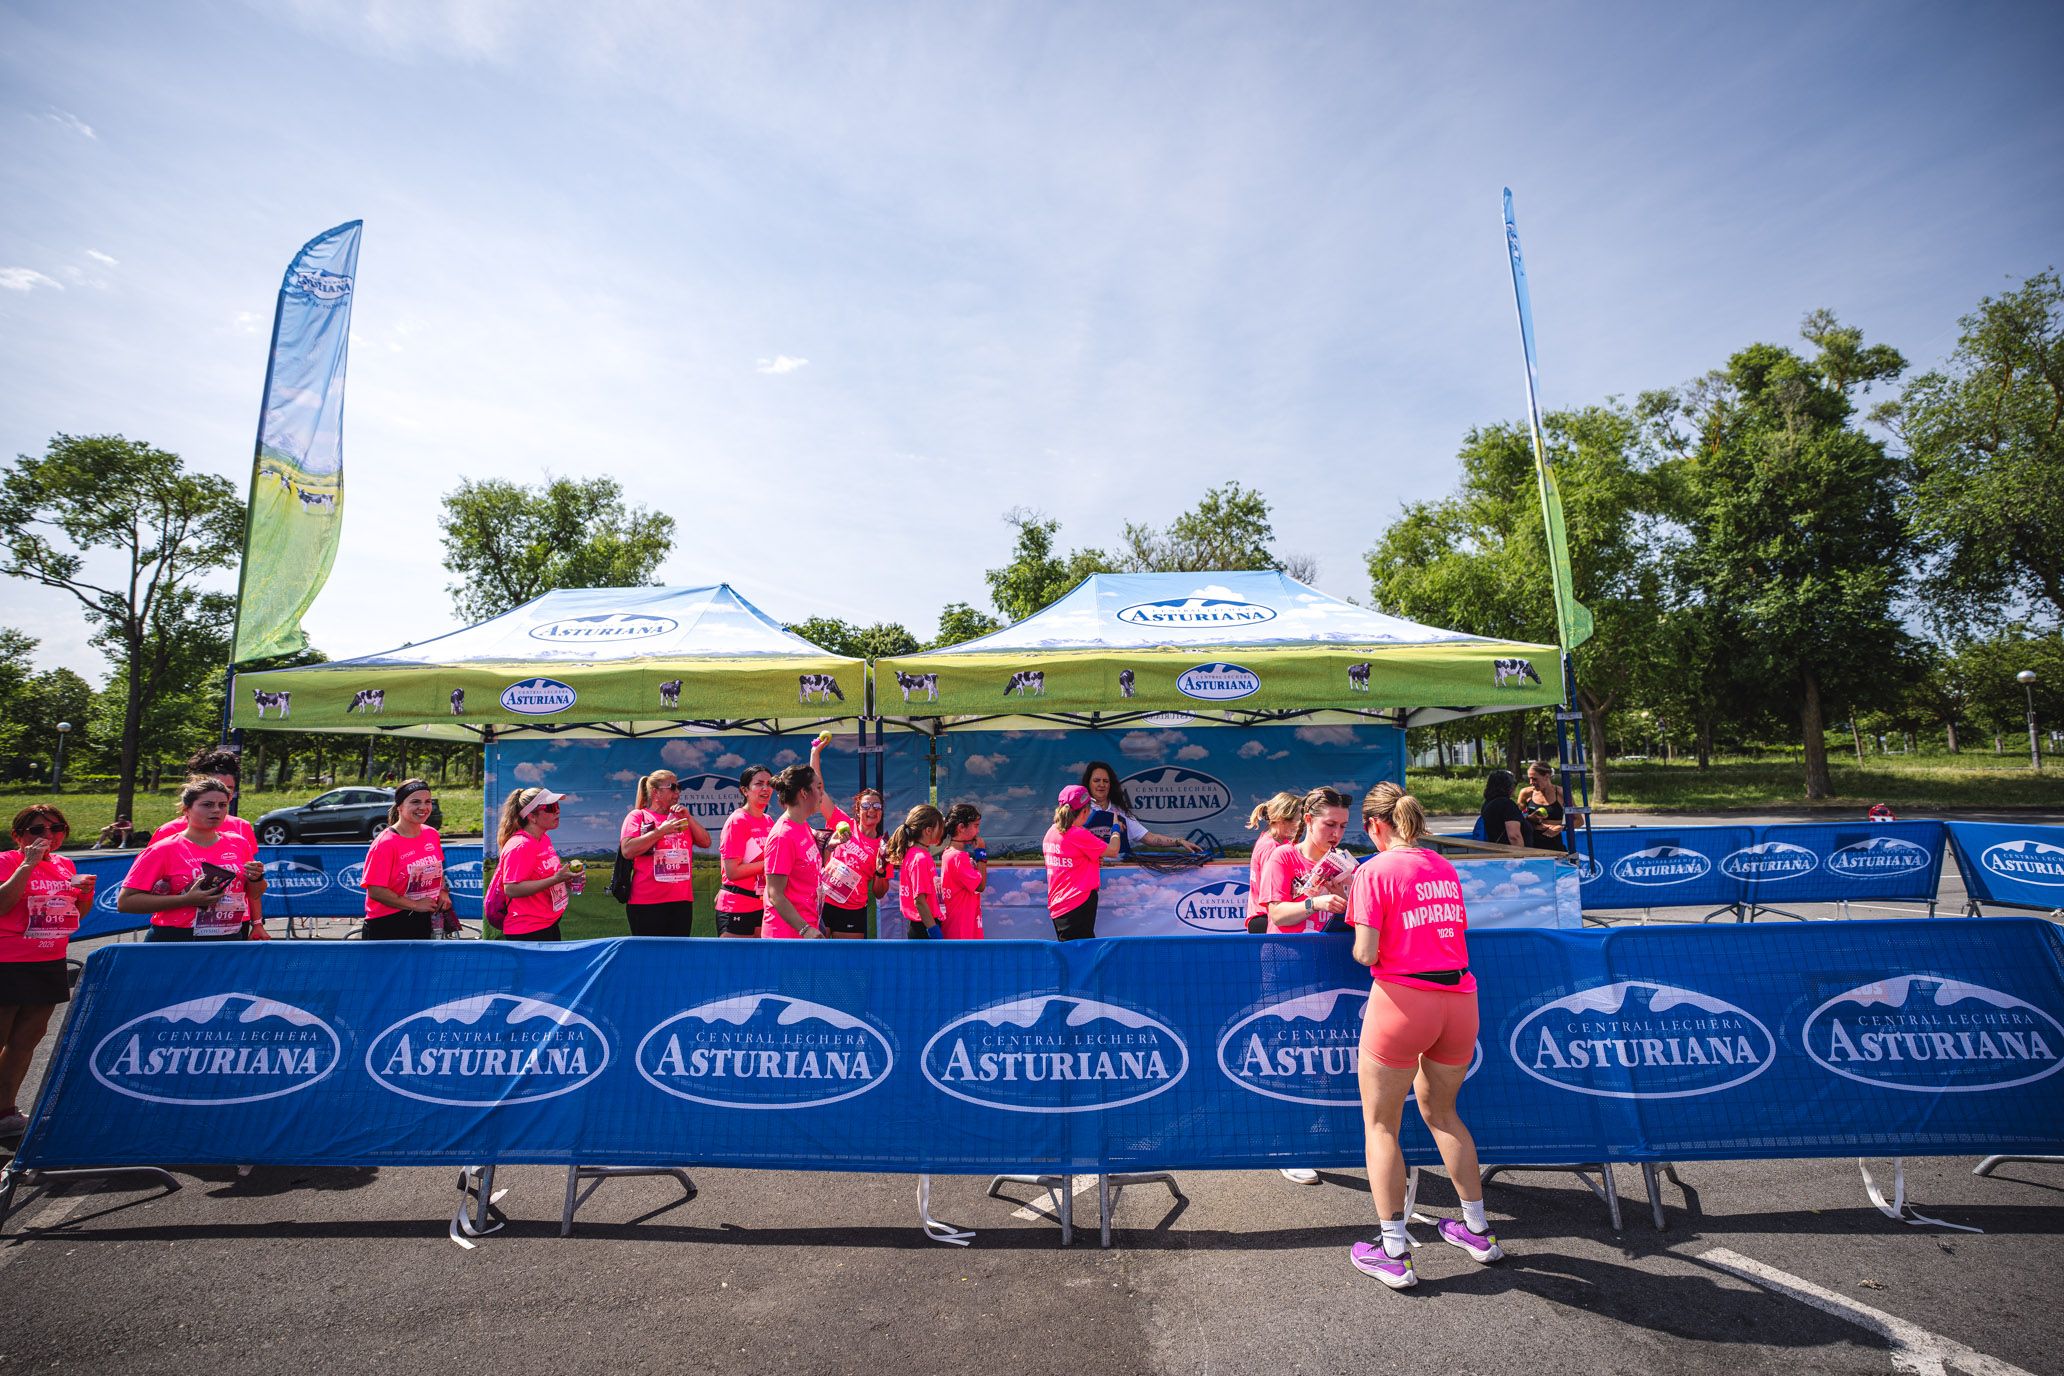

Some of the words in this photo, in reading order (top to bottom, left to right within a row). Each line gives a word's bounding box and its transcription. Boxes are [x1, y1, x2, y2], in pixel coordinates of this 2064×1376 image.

[1131, 609, 1265, 622] ASTURIANA
[539, 625, 664, 637] ASTURIANA
[1184, 676, 1254, 690] ASTURIANA
[507, 691, 570, 705] ASTURIANA
[1728, 857, 1811, 873] ASTURIANA
[1835, 851, 1922, 868] ASTURIANA
[1621, 862, 1704, 877] ASTURIANA
[31, 879, 75, 890] CARRER
[1415, 880, 1460, 902] SOMOS
[216, 911, 234, 919] 016
[1185, 900, 1247, 920] ASTURI
[46, 915, 65, 923] 016
[1567, 1021, 1653, 1033] CENTRAL
[1661, 1017, 1742, 1032] LECHERA
[1858, 1013, 1941, 1027] CENTRAL
[1948, 1012, 2034, 1026] LECHERA
[158, 1030, 233, 1041] CENTRAL
[241, 1030, 318, 1041] LECHERA
[427, 1031, 502, 1042] CENTRAL
[509, 1031, 585, 1042] LECHERA
[696, 1031, 775, 1045] CENTRAL
[782, 1033, 866, 1045] LECHERA
[982, 1034, 1065, 1046] CENTRAL
[1072, 1033, 1159, 1045] LECHERA
[1827, 1017, 2056, 1062] ASTURIANA
[108, 1033, 318, 1076] ASTURIANA
[381, 1033, 589, 1076] ASTURIANA
[1533, 1024, 1760, 1070] ASTURIANA
[652, 1033, 873, 1080] ASTURIANA
[941, 1037, 1170, 1082] ASTURIANA
